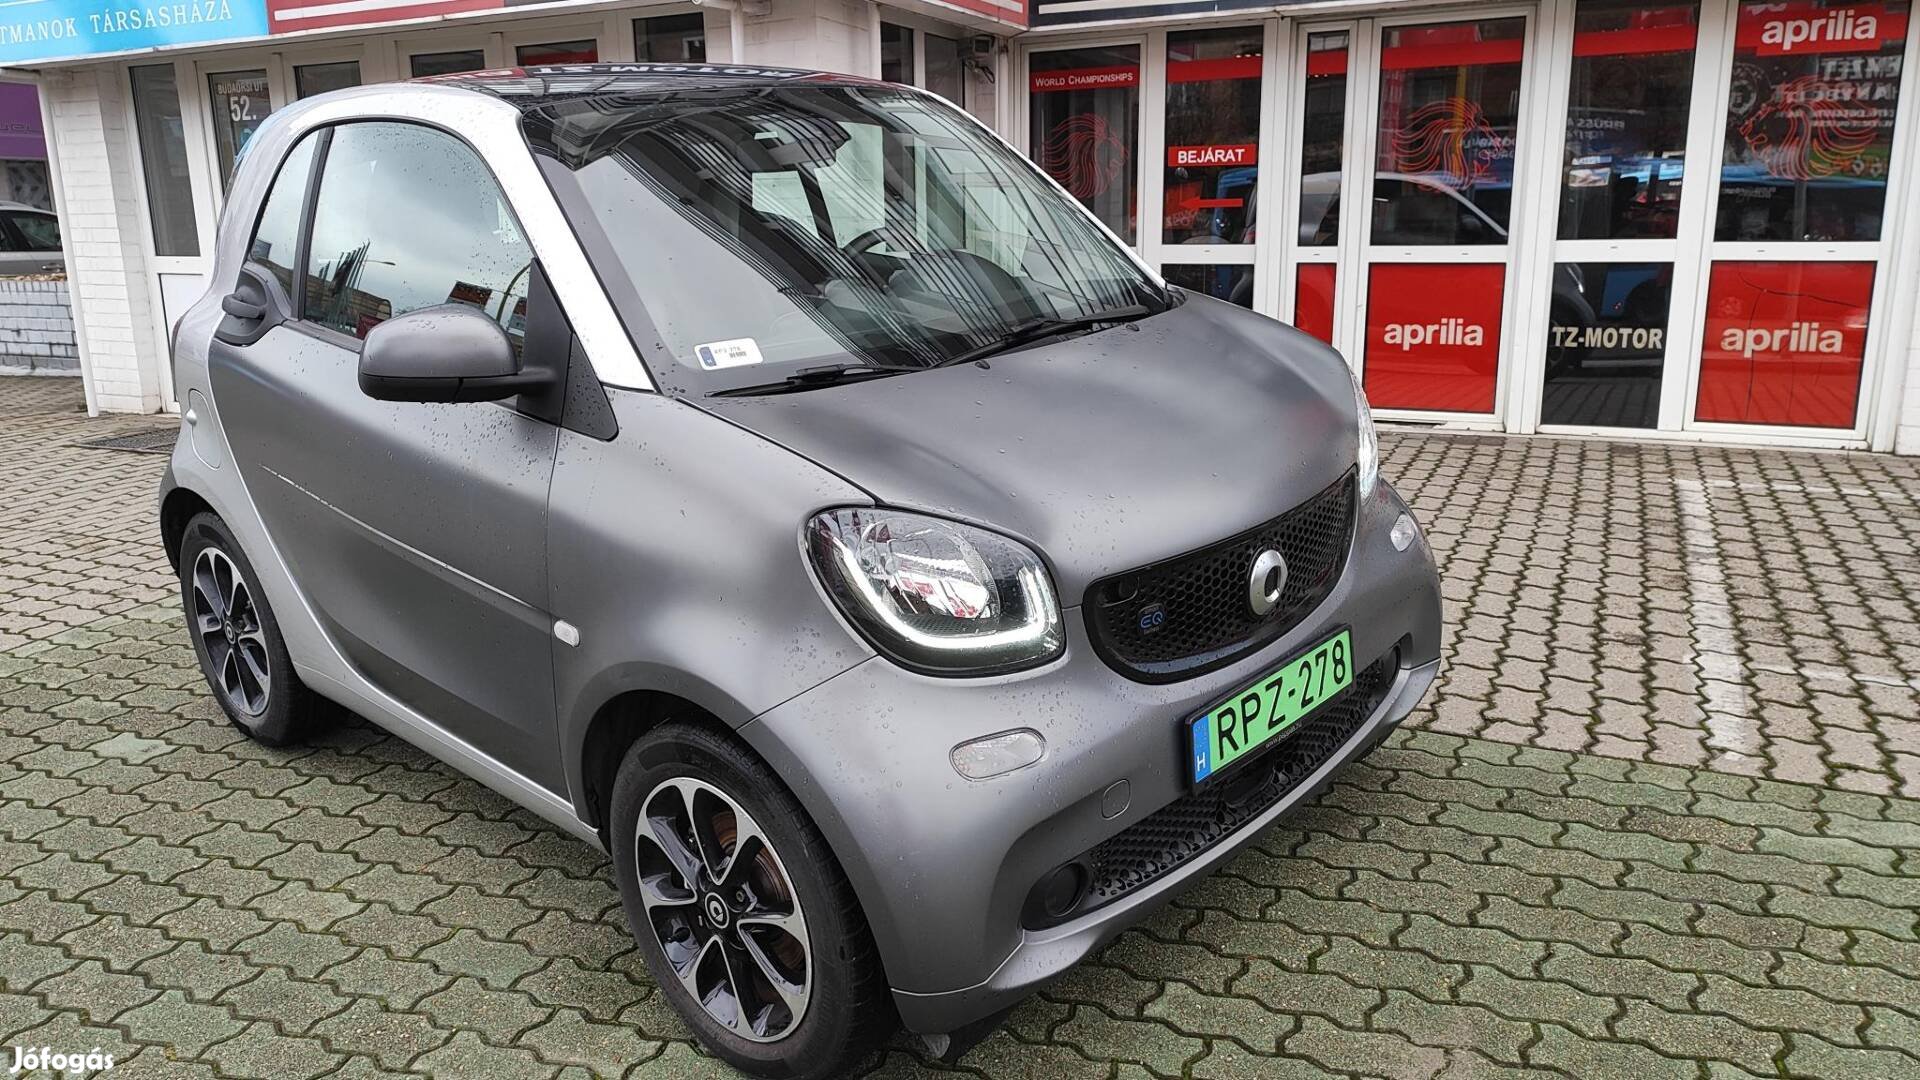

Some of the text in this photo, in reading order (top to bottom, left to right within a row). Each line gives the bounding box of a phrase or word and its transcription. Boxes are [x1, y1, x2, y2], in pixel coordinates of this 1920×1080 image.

[1761, 9, 1877, 51] aprilia
[1035, 72, 1134, 87] WORLD CHAMPIONSHIPS
[230, 95, 257, 122] 52.
[1177, 147, 1246, 164] BEJÁRAT
[1383, 317, 1484, 351] aprilia
[1552, 325, 1663, 350] TZ-MOTOR
[1720, 320, 1843, 358] aprilia
[1215, 638, 1346, 761] RPZ-278
[1195, 753, 1206, 772] H
